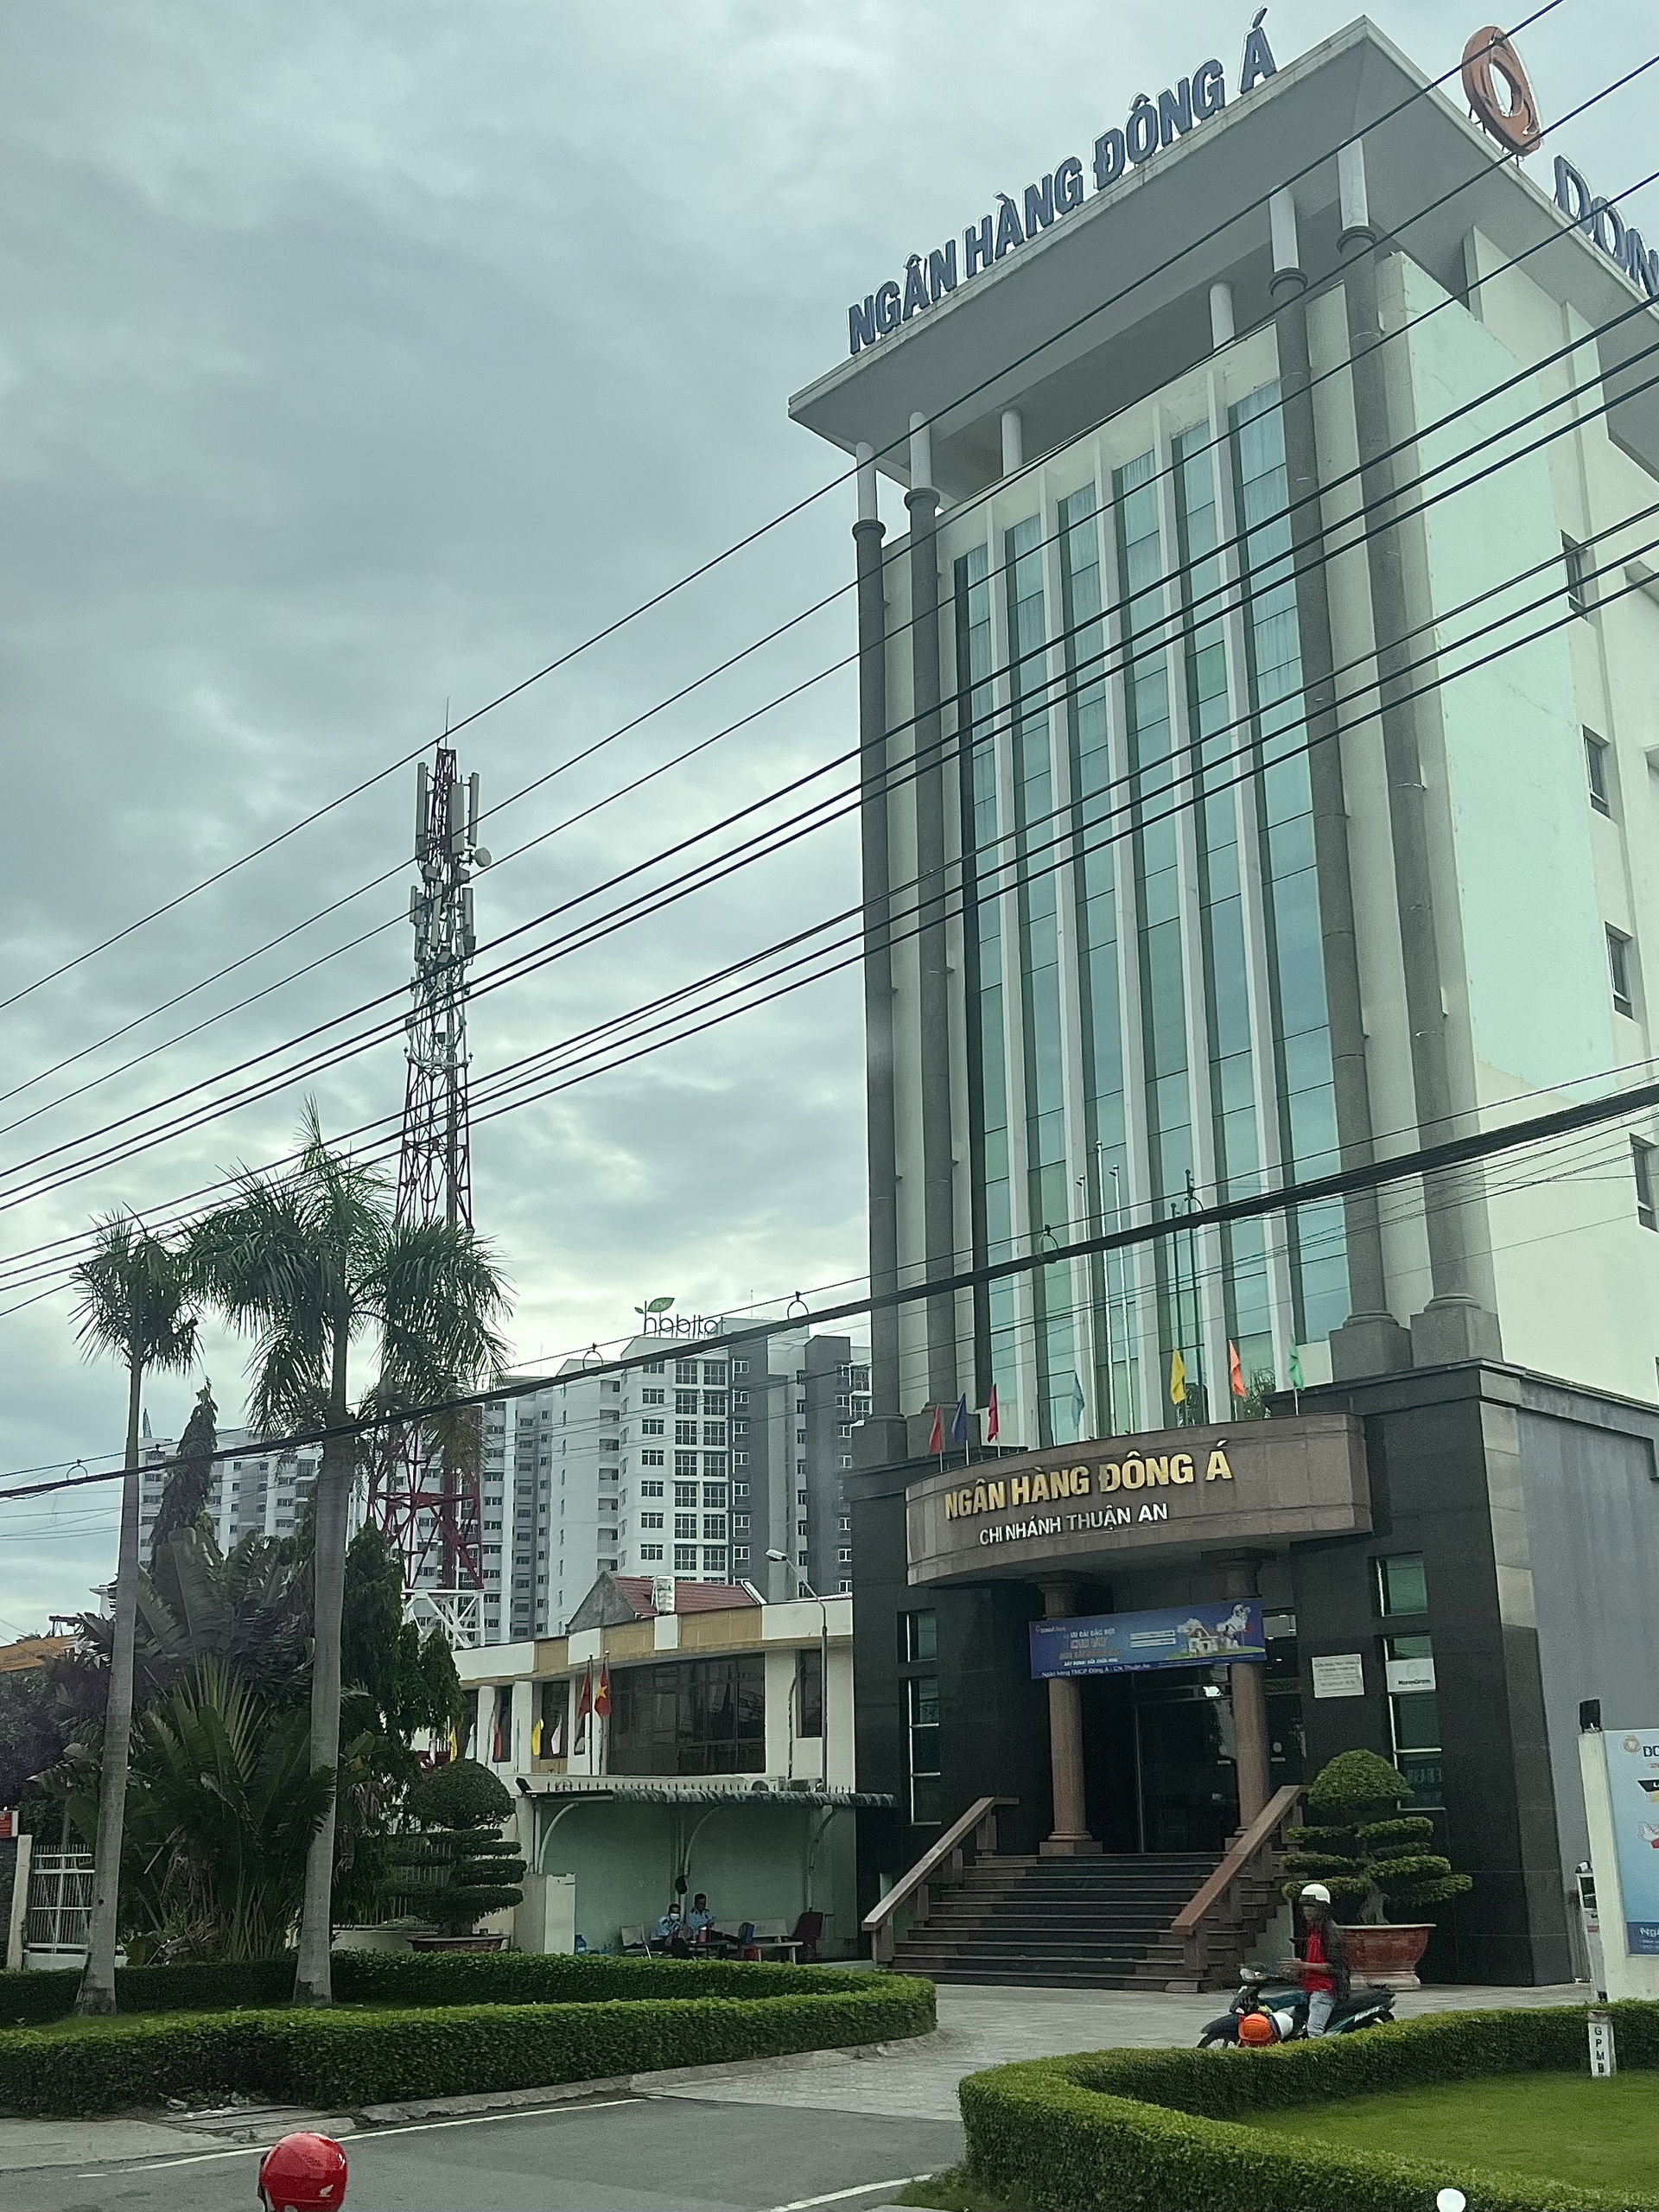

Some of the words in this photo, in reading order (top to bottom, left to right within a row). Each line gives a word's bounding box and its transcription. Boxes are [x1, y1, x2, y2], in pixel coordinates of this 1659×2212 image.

[847, 239, 957, 354] NGÂN
[963, 156, 1084, 278] HÀNG
[1091, 58, 1225, 191] ĐÔNG
[1239, 4, 1277, 94] Á
[944, 1478, 1006, 1520] NGÂN
[1011, 1465, 1090, 1506] HÀNG
[1098, 1451, 1194, 1492] ĐÔNG
[1205, 1440, 1232, 1481] Á
[979, 1525, 1002, 1546] CHI
[1006, 1516, 1061, 1541] NHÁNH
[1066, 1504, 1131, 1531] THUẬN
[1138, 1503, 1167, 1522] AN
